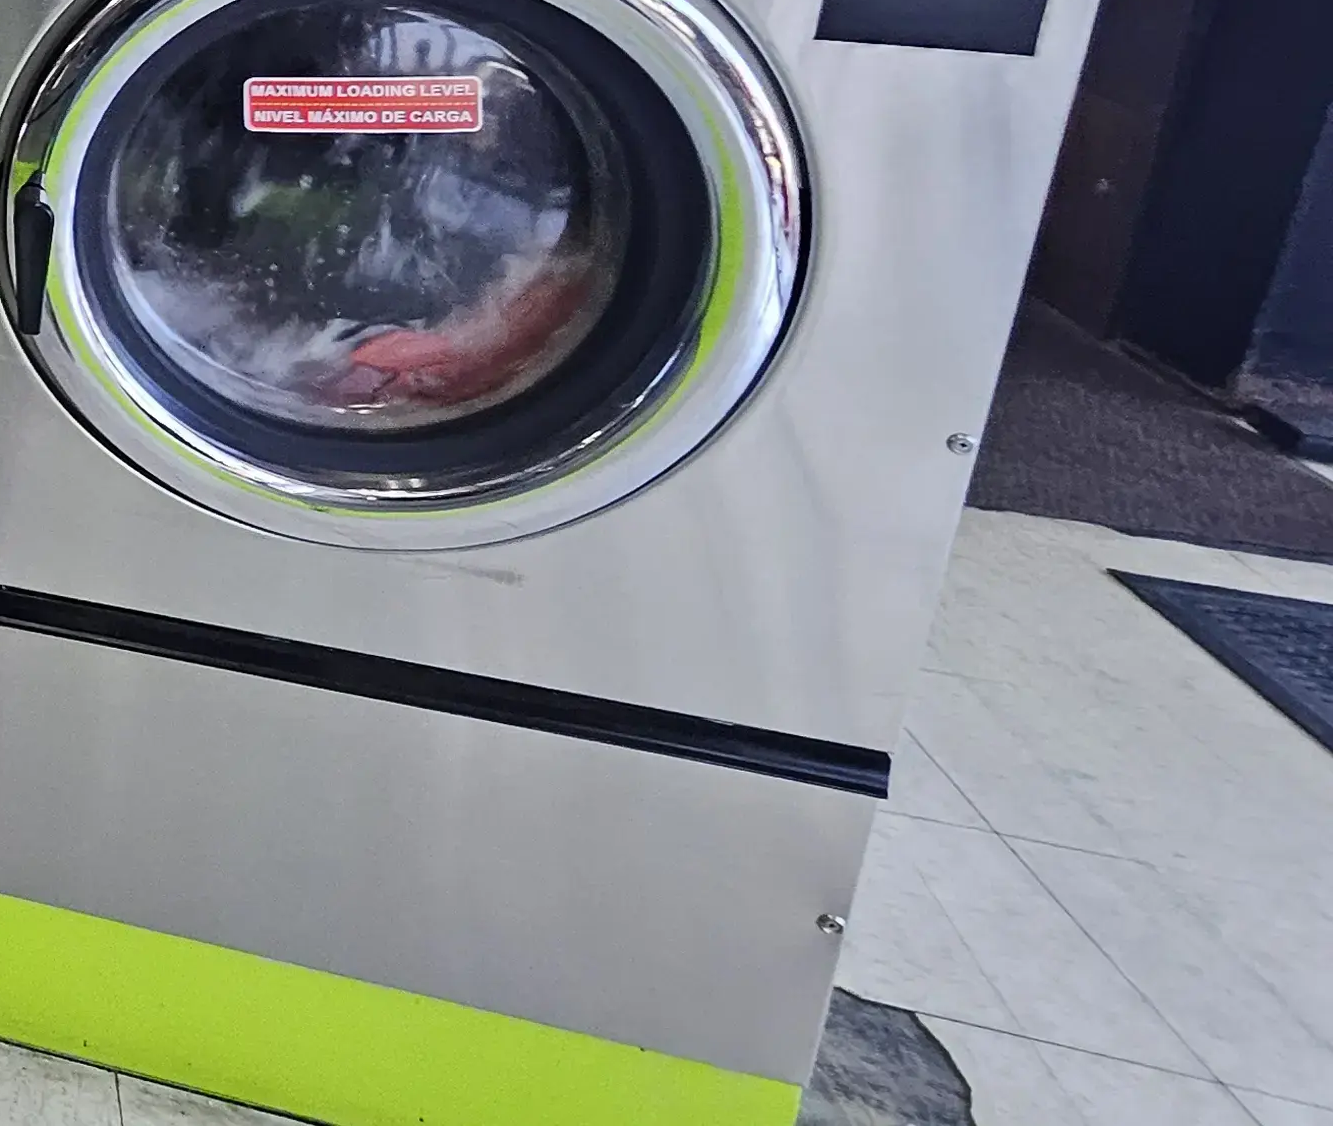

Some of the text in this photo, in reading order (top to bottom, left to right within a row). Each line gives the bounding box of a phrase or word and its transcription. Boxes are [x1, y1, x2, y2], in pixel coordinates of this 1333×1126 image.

[251, 84, 475, 98] MAXIMUM LOADING LEVEL
[253, 108, 473, 123] NIVEL MÁXIMO DE CARGA
